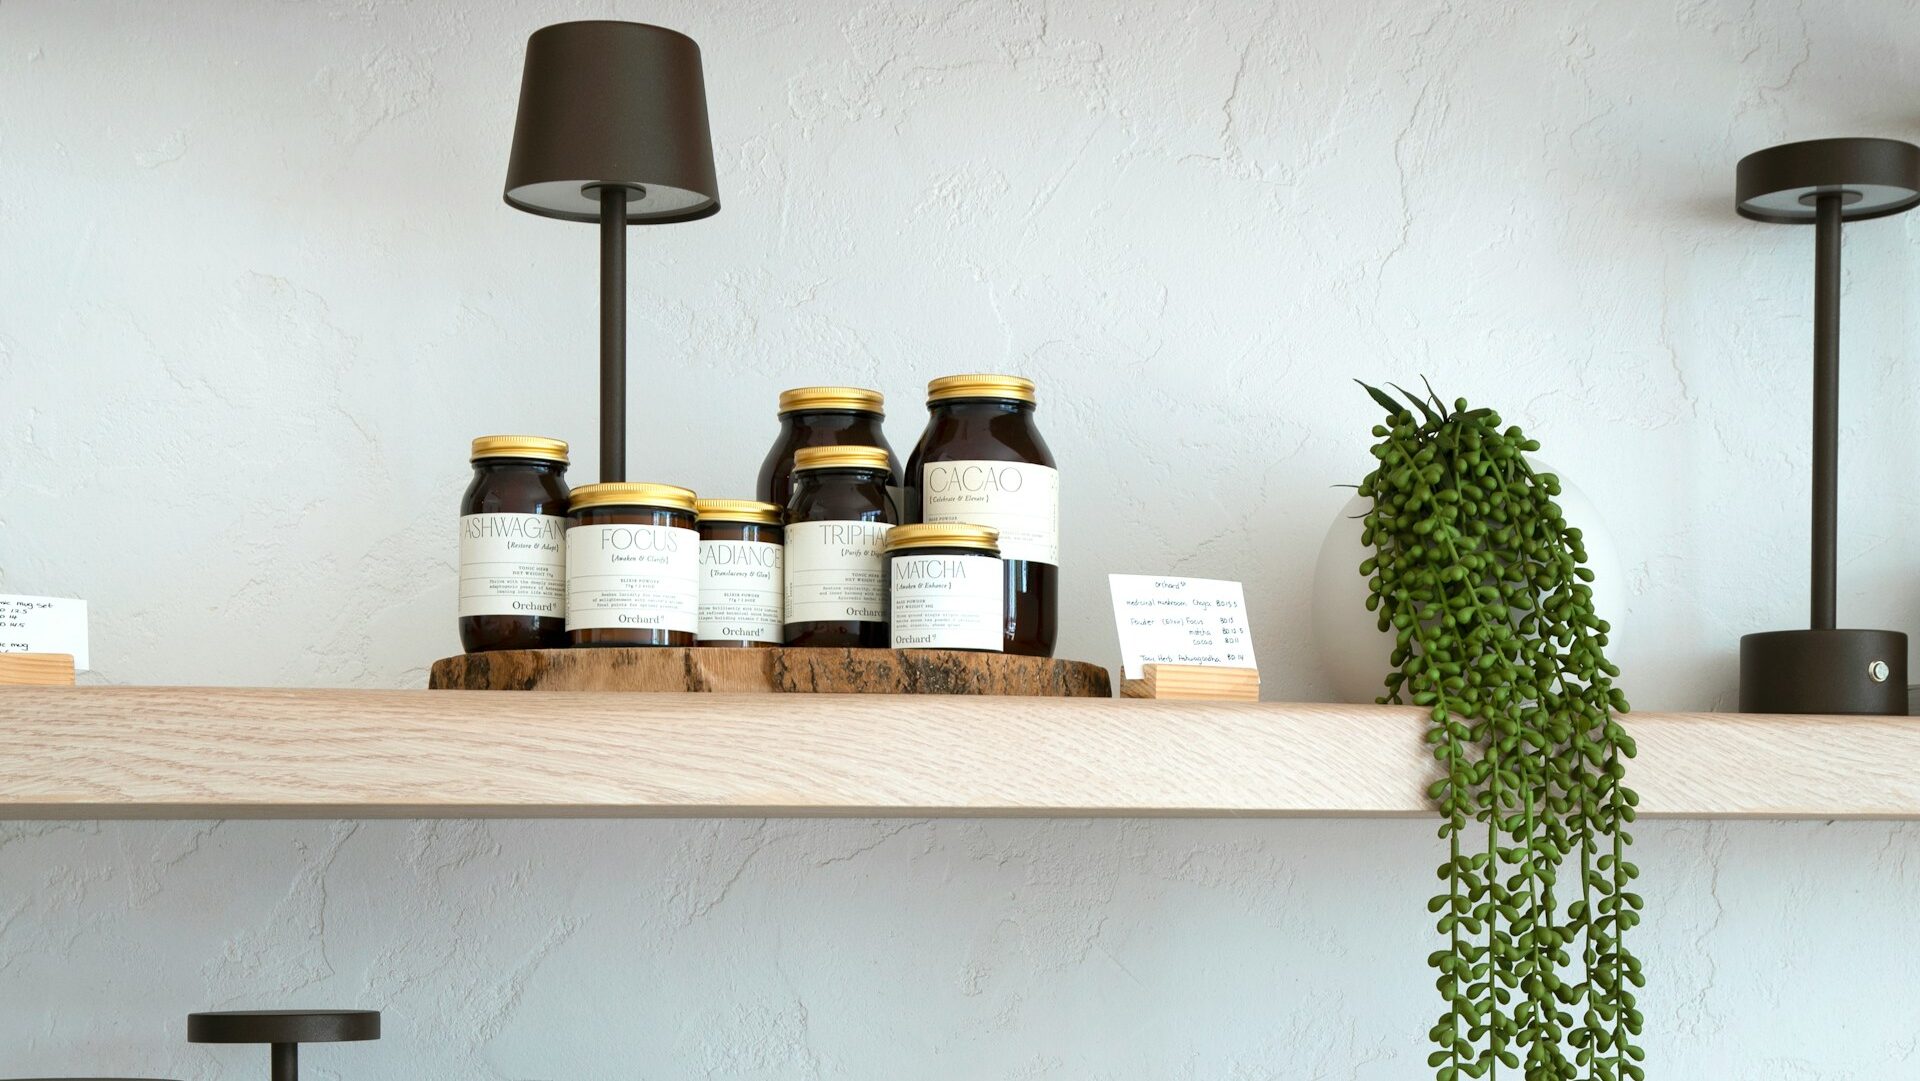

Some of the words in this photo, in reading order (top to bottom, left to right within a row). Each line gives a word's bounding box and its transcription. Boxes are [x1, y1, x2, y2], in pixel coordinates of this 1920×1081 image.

[929, 465, 1023, 493] CACAO
[601, 527, 678, 553] FOCUS
[895, 559, 967, 580] MATCHA
